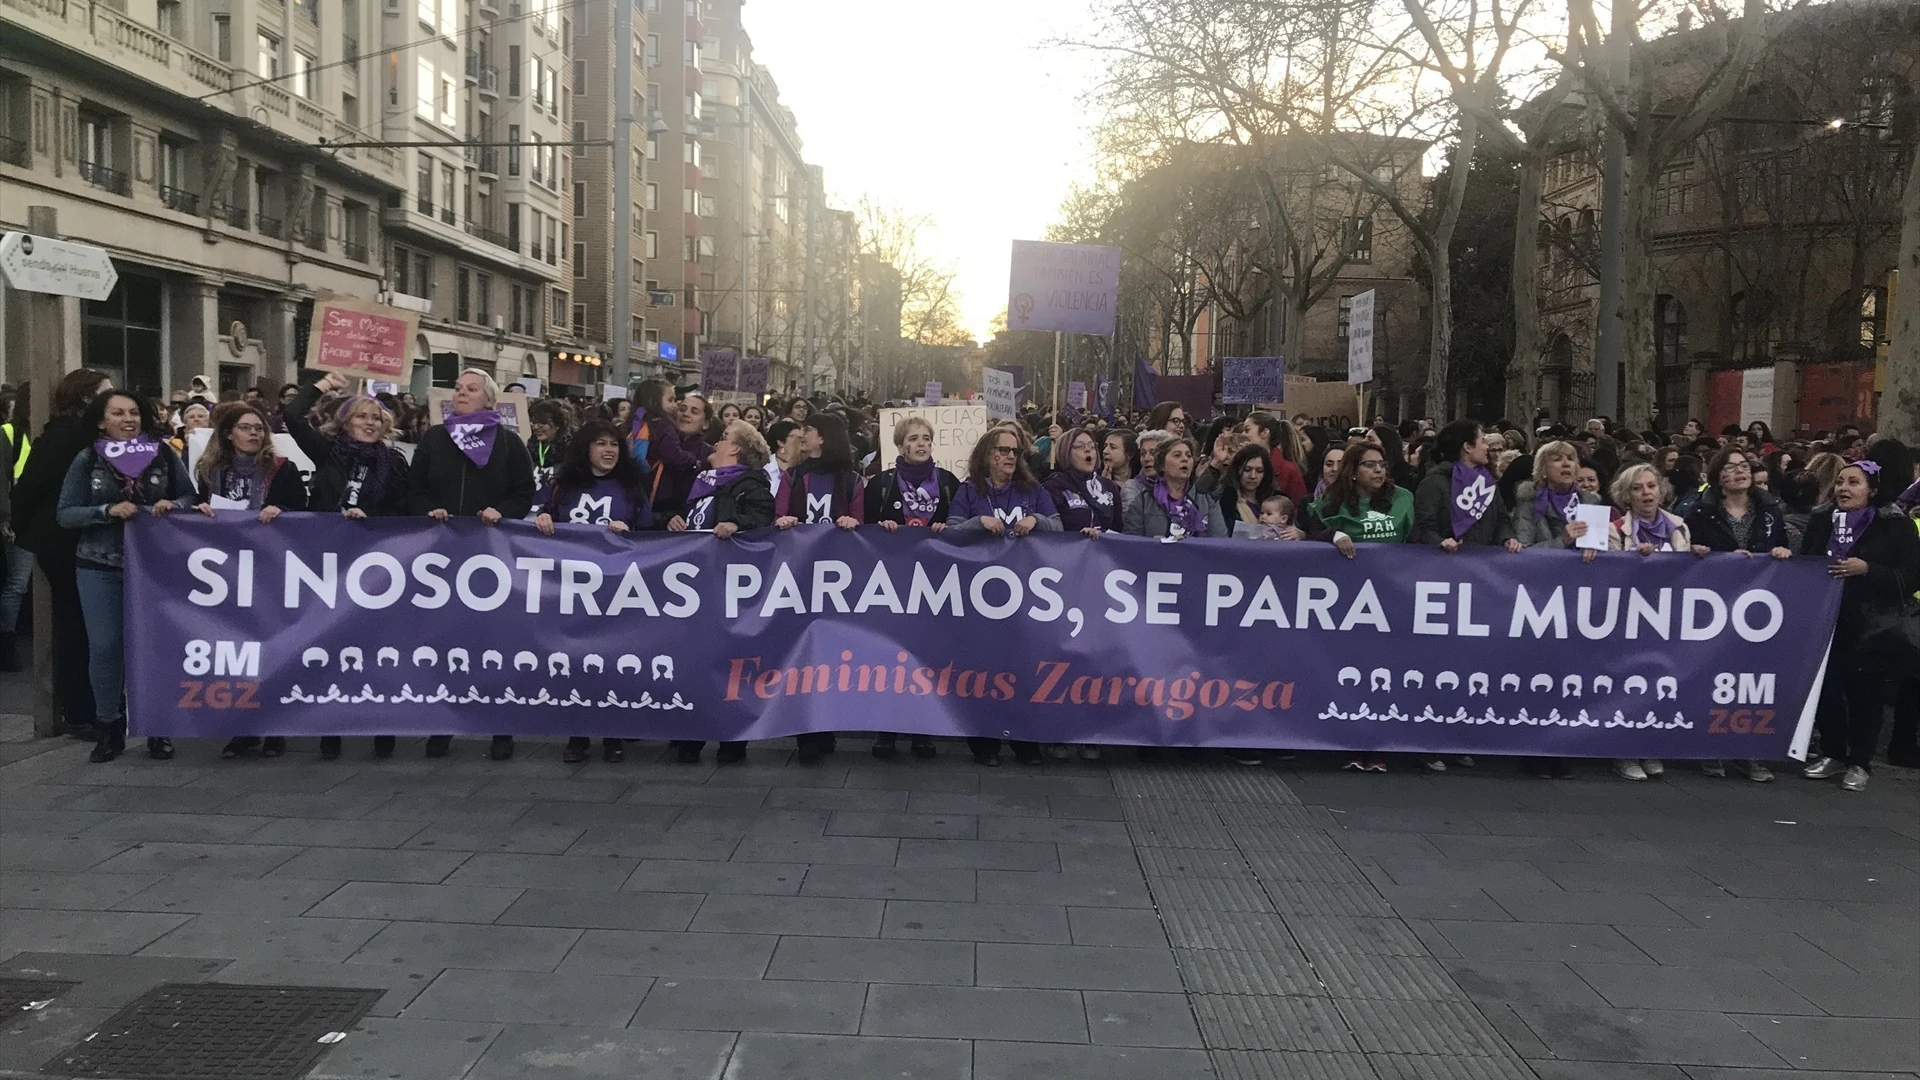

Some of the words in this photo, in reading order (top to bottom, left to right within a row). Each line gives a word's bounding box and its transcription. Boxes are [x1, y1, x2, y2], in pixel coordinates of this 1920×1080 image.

[1060, 248, 1112, 269] SALARIAL
[1088, 270, 1104, 285] ES
[1045, 289, 1108, 314] VIOLENCIA
[359, 318, 391, 338] Mujer
[359, 352, 371, 362] DE
[1362, 531, 1397, 539] ZARAGOZA
[1363, 519, 1395, 533] PAH
[187, 547, 254, 608] SI
[283, 549, 701, 619] NOSOTRAS
[725, 560, 1085, 638] PARAMOS,
[1103, 569, 1183, 625] SE
[1205, 572, 1391, 633] PARA
[1412, 580, 1490, 637] EL
[1508, 583, 1784, 643] MUNDO
[182, 639, 262, 677] 8M
[178, 680, 261, 710] ZGZ
[723, 649, 1018, 703] Feministas
[1030, 659, 1297, 722] Zaragoza
[1711, 672, 1777, 705] 8M
[1707, 708, 1777, 735] ZGZ
